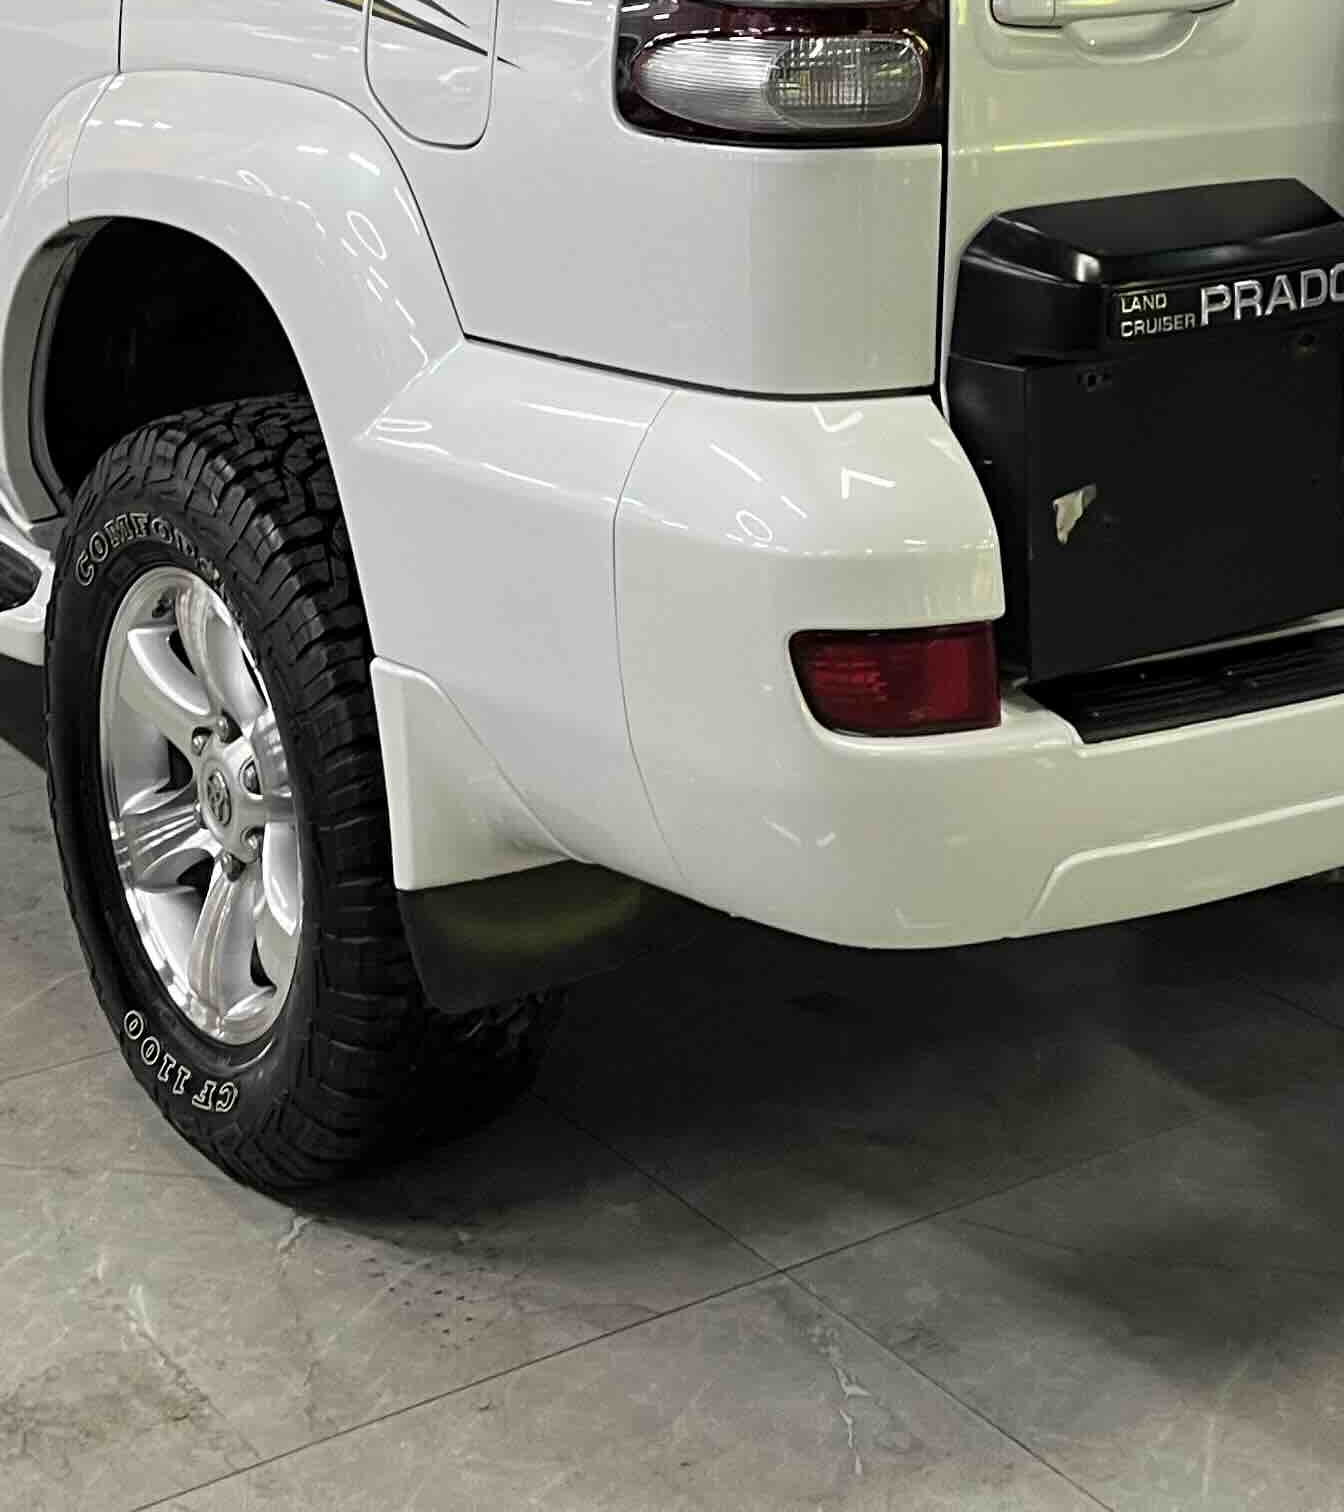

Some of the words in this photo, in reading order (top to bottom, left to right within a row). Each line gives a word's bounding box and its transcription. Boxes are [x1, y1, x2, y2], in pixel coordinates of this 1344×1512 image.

[1120, 292, 1168, 314] LAND
[1120, 313, 1197, 337] CRUISER
[123, 1009, 192, 1095] 1100
